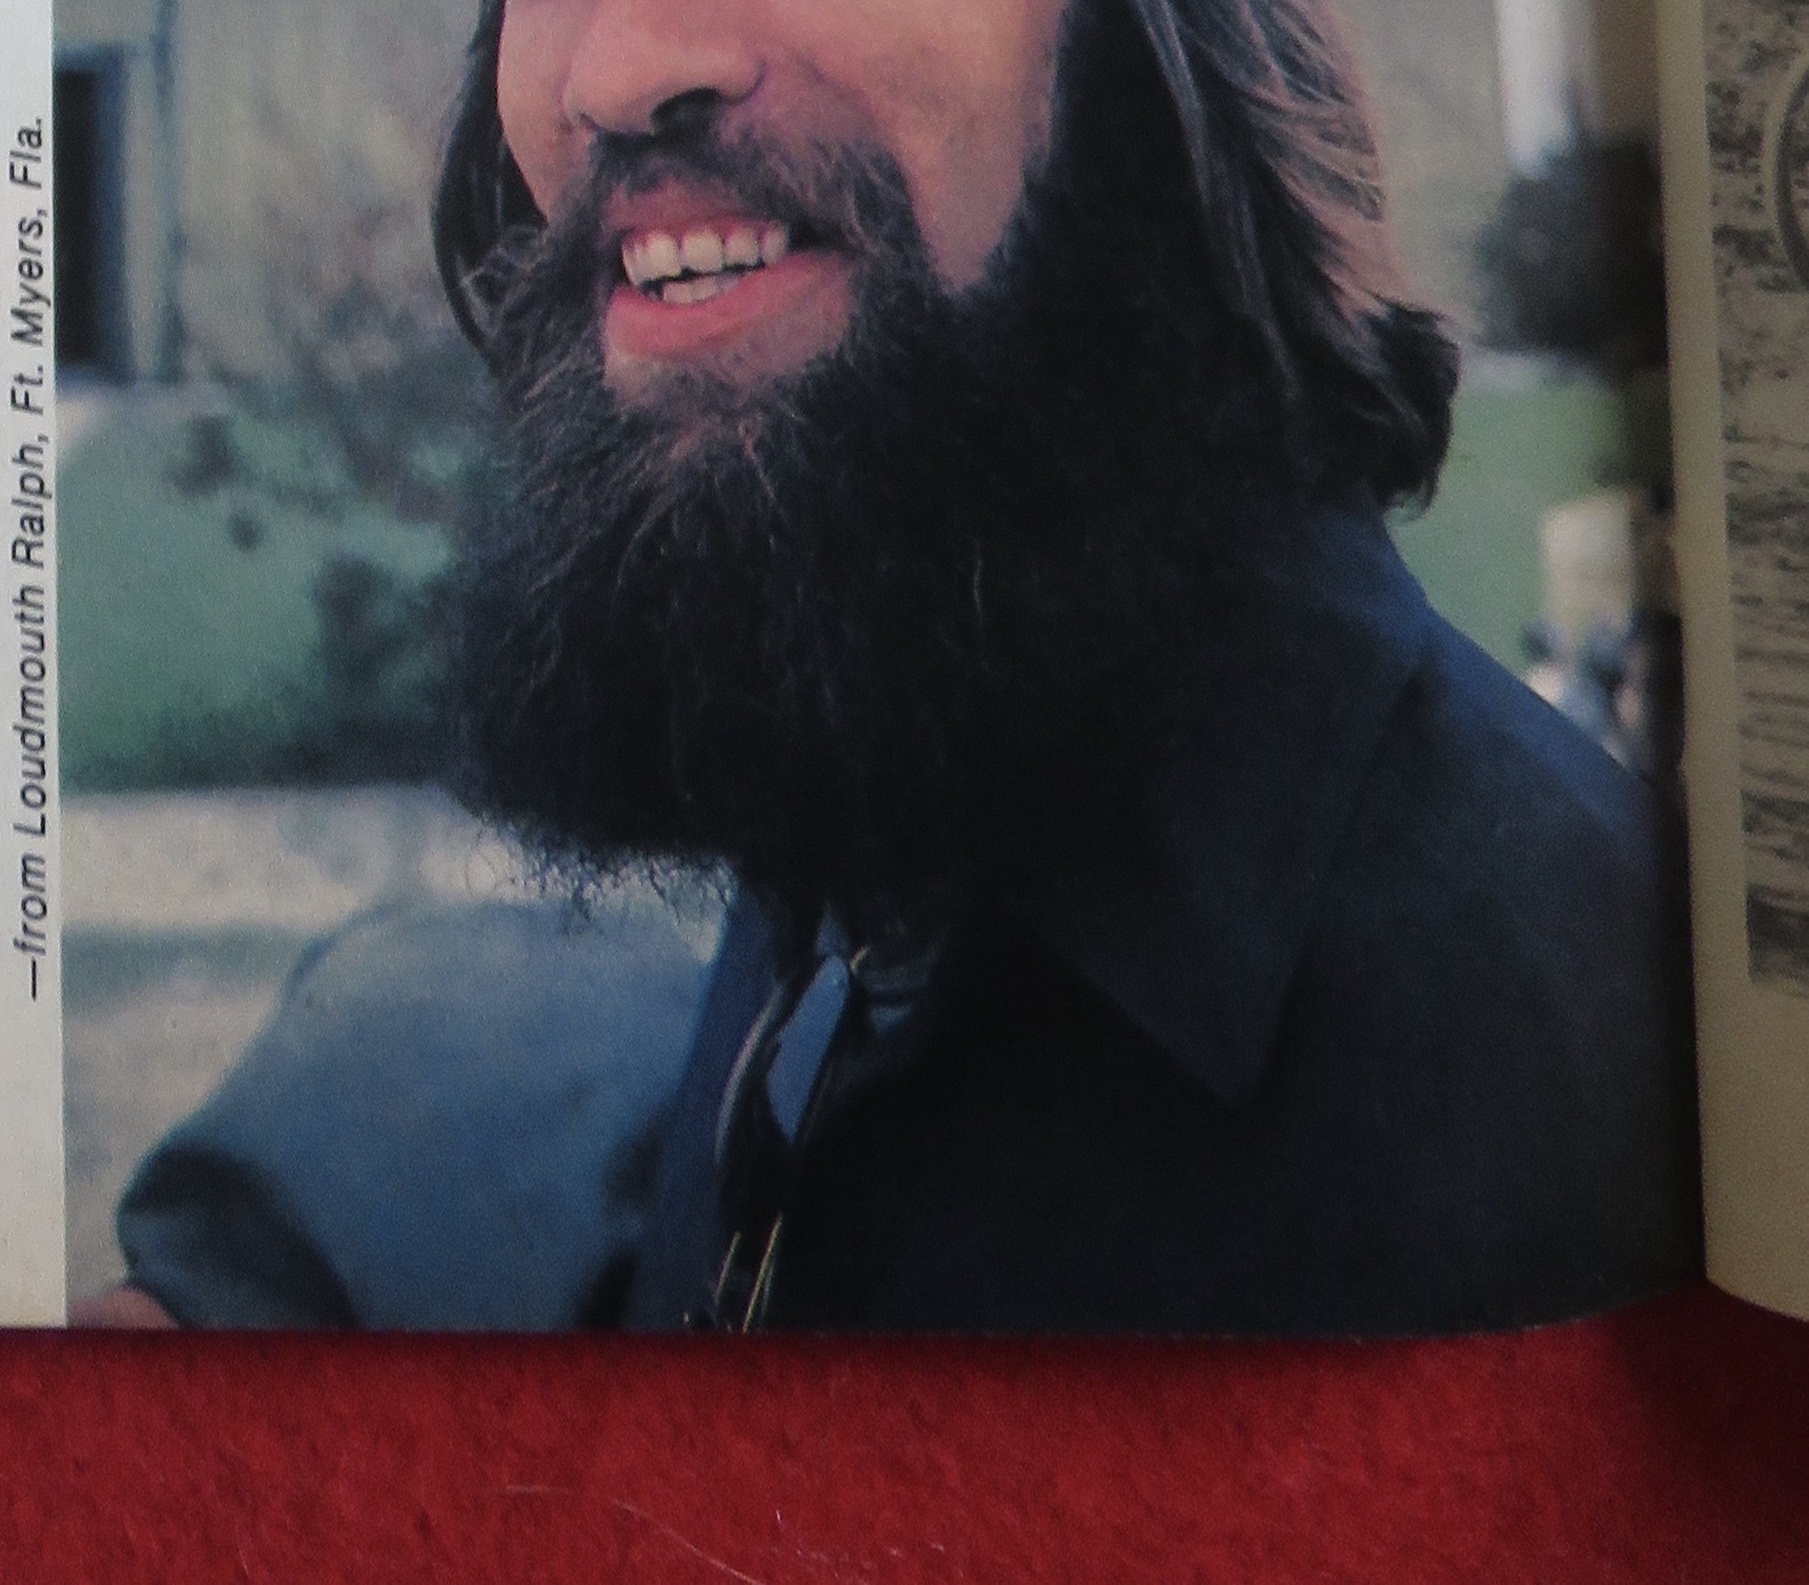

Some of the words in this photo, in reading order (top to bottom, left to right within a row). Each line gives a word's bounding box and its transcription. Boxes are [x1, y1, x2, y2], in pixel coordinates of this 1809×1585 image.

[7, 114, 45, 190] Fla.
[8, 208, 52, 347] Myers,
[9, 364, 45, 416] Ft.
[10, 434, 52, 570] Ralph,
[11, 584, 48, 838] Loudmouth
